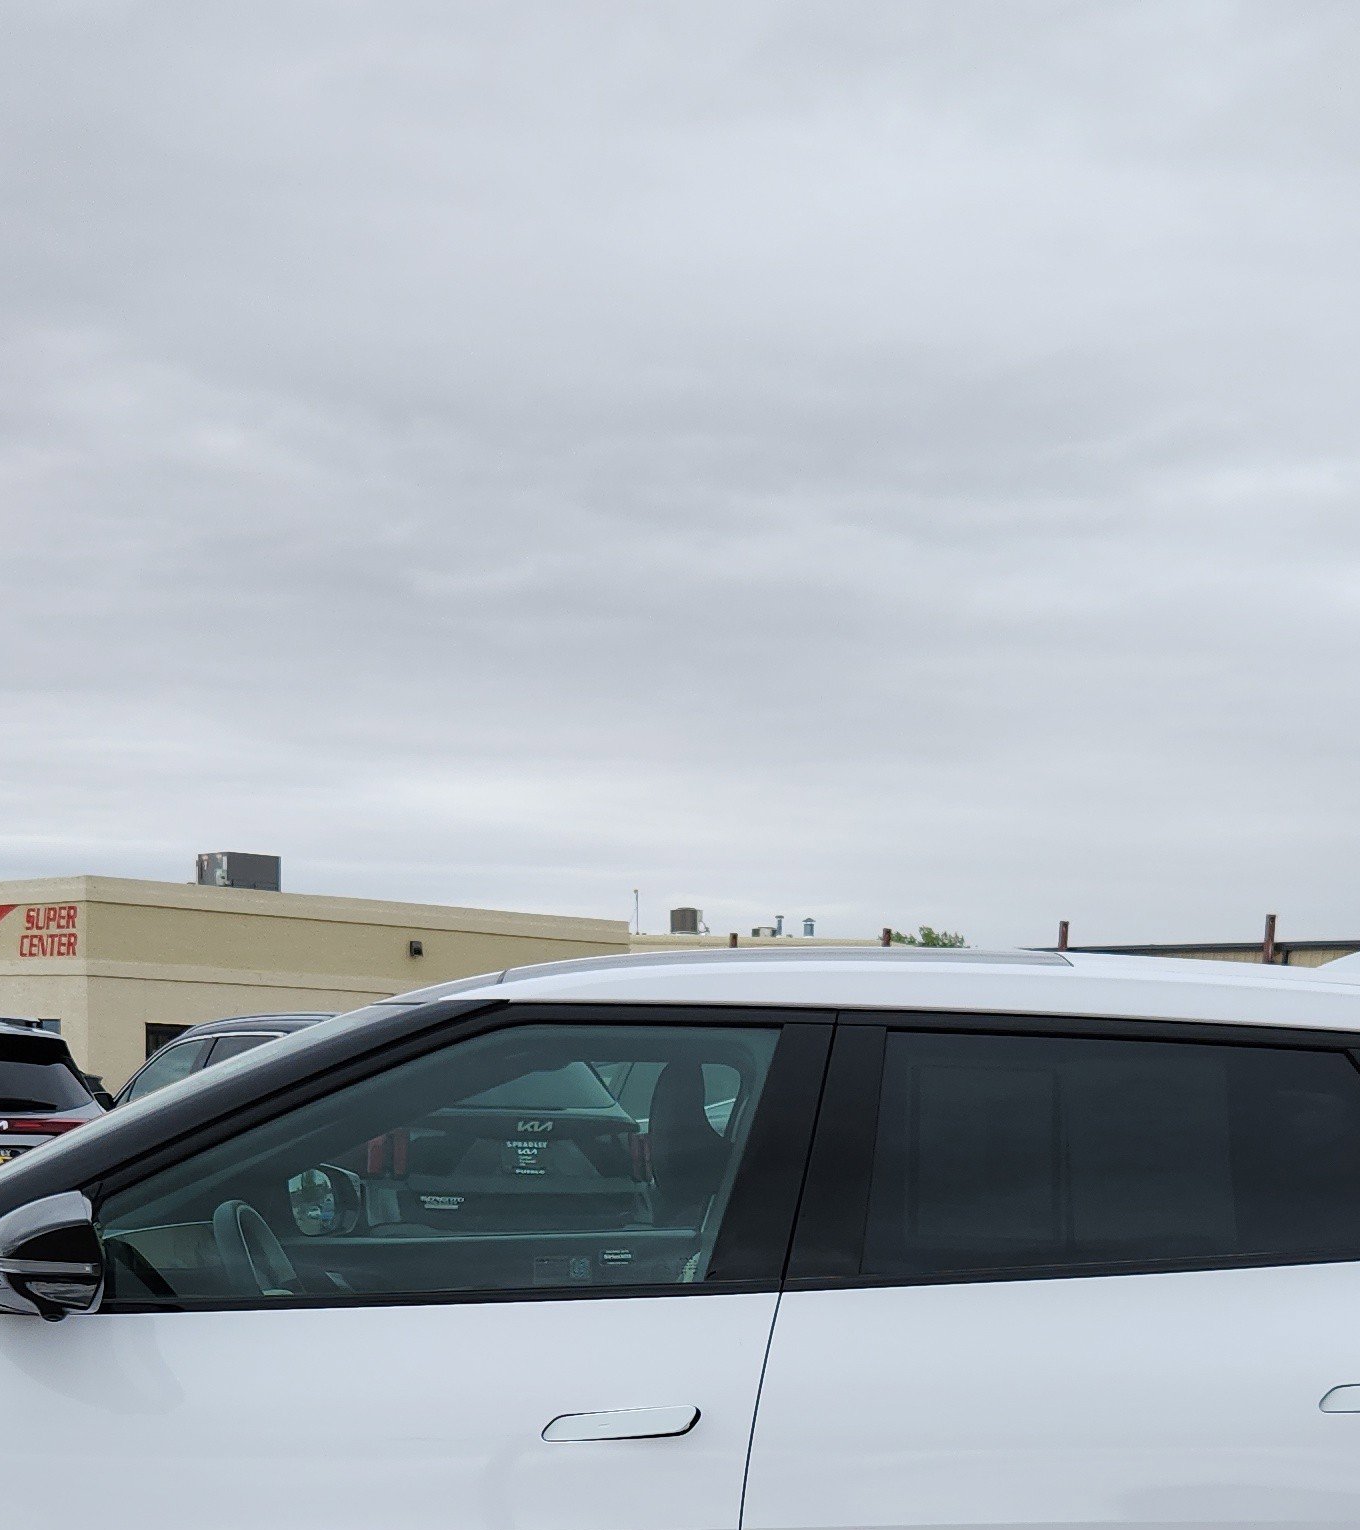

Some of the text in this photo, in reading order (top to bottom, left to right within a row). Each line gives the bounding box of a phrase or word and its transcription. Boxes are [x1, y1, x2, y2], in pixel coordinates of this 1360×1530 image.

[25, 905, 78, 931] SUPER
[19, 932, 78, 958] CENTER
[517, 1121, 554, 1132] KIA
